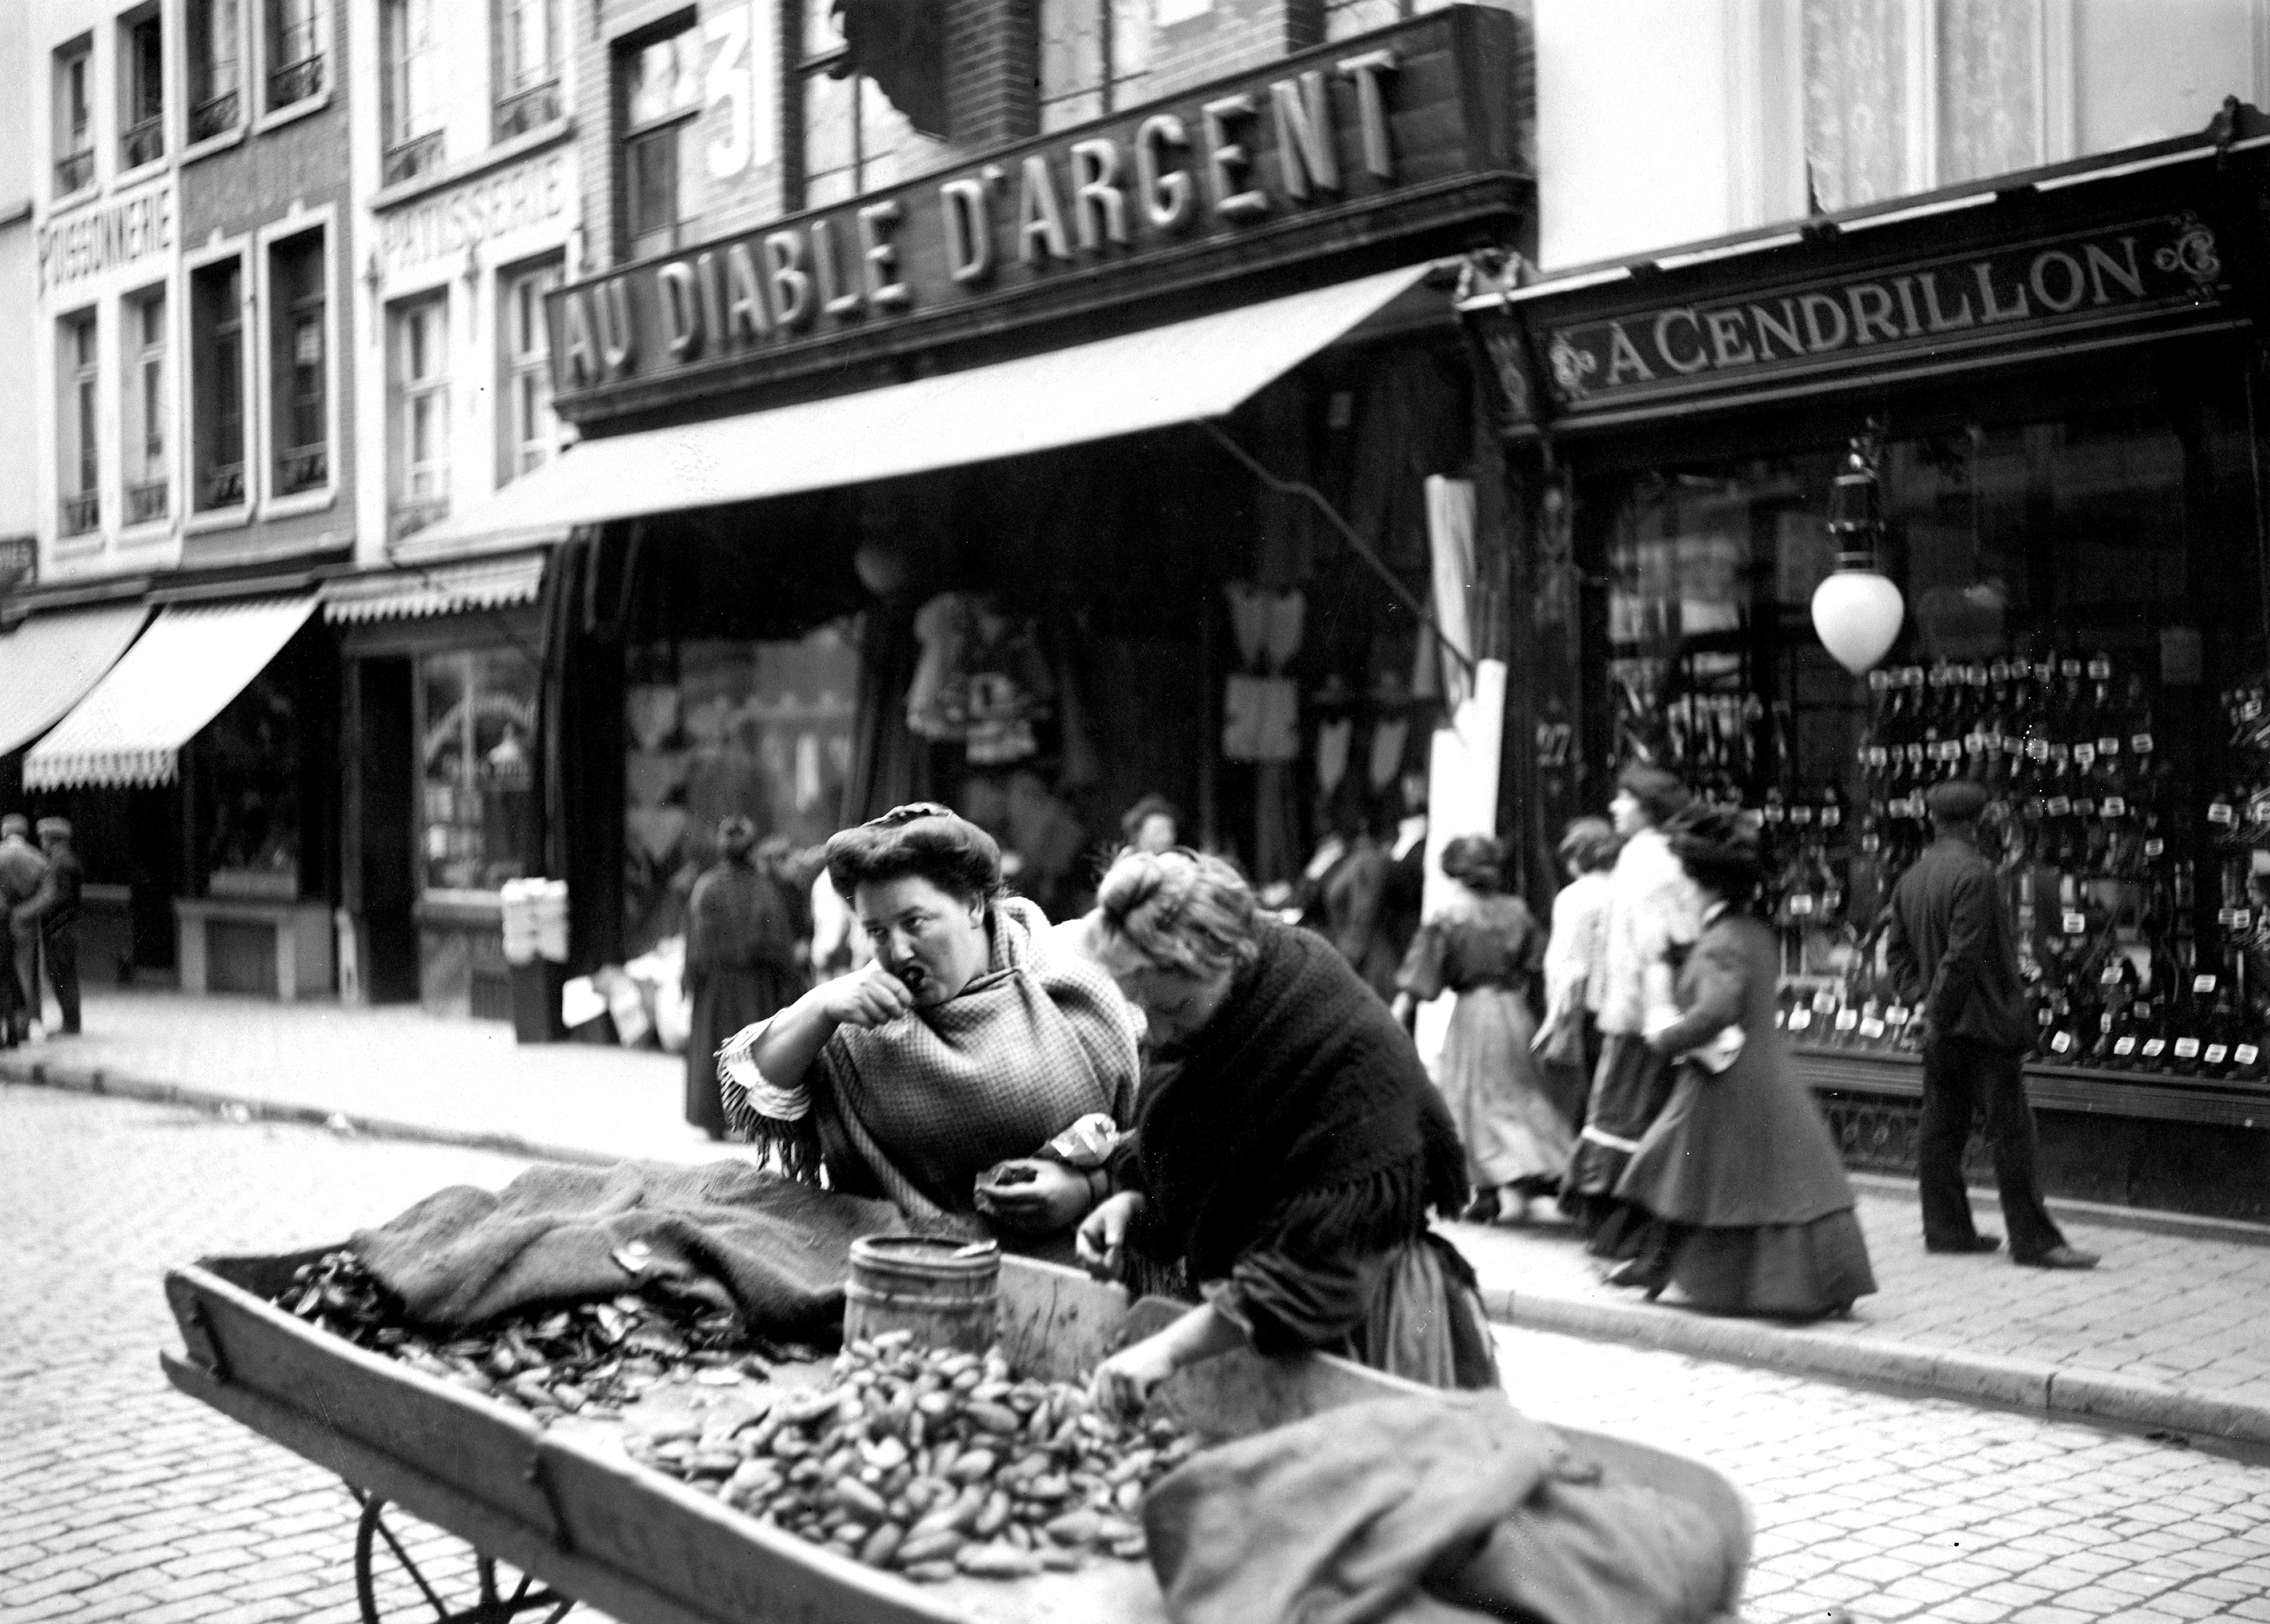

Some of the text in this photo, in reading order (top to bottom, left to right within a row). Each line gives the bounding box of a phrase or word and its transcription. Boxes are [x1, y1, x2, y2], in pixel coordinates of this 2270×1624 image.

[561, 47, 1396, 388] AU DIABLE D'ARGENT
[1606, 236, 2150, 385] A CENDRILLON
